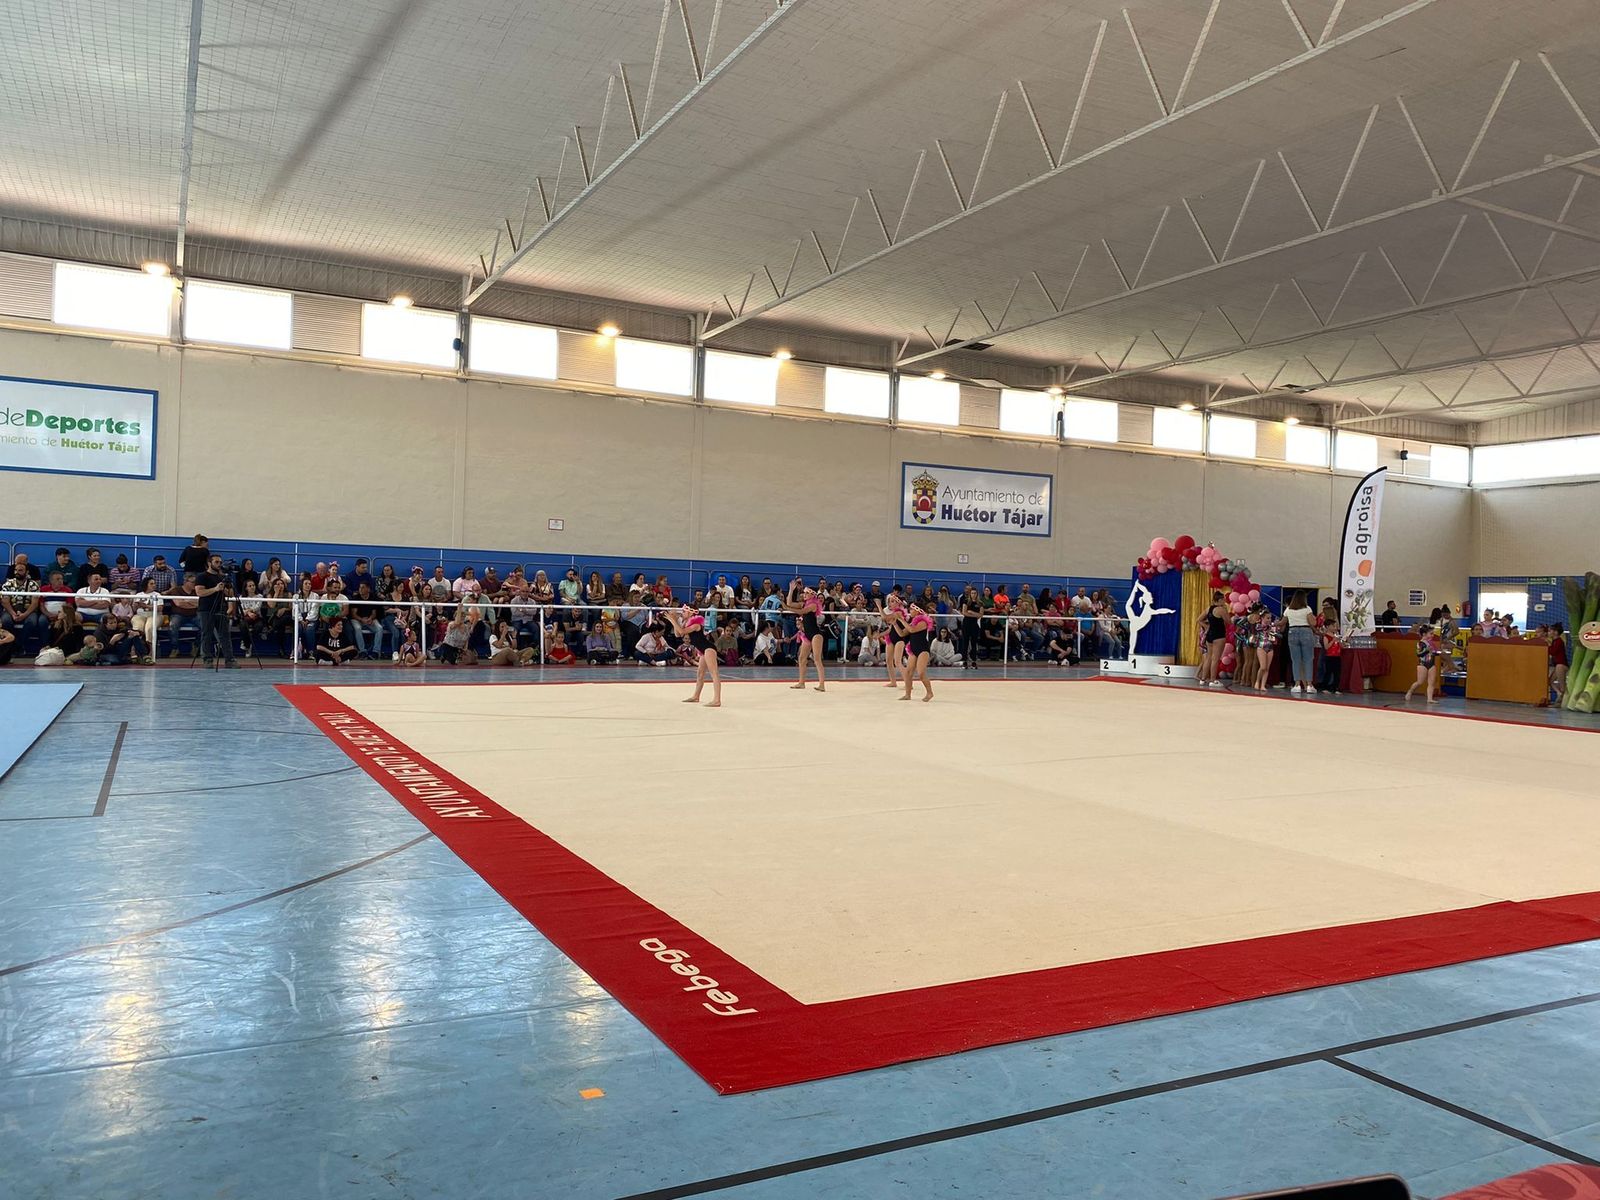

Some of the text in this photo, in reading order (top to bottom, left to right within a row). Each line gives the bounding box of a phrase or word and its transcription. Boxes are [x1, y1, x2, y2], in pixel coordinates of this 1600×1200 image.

[41, 436, 57, 447] de
[61, 437, 104, 450] Huétor
[108, 441, 140, 453] Tájar
[942, 485, 1044, 506] Ayuntamiento de
[941, 504, 1043, 528] Huétor Tájar
[1356, 486, 1373, 555] agroisa
[1103, 661, 1109, 670] 2
[1131, 658, 1137, 669] 1
[1164, 665, 1171, 676] 3
[372, 755, 493, 818] AYUNTAMIENTO
